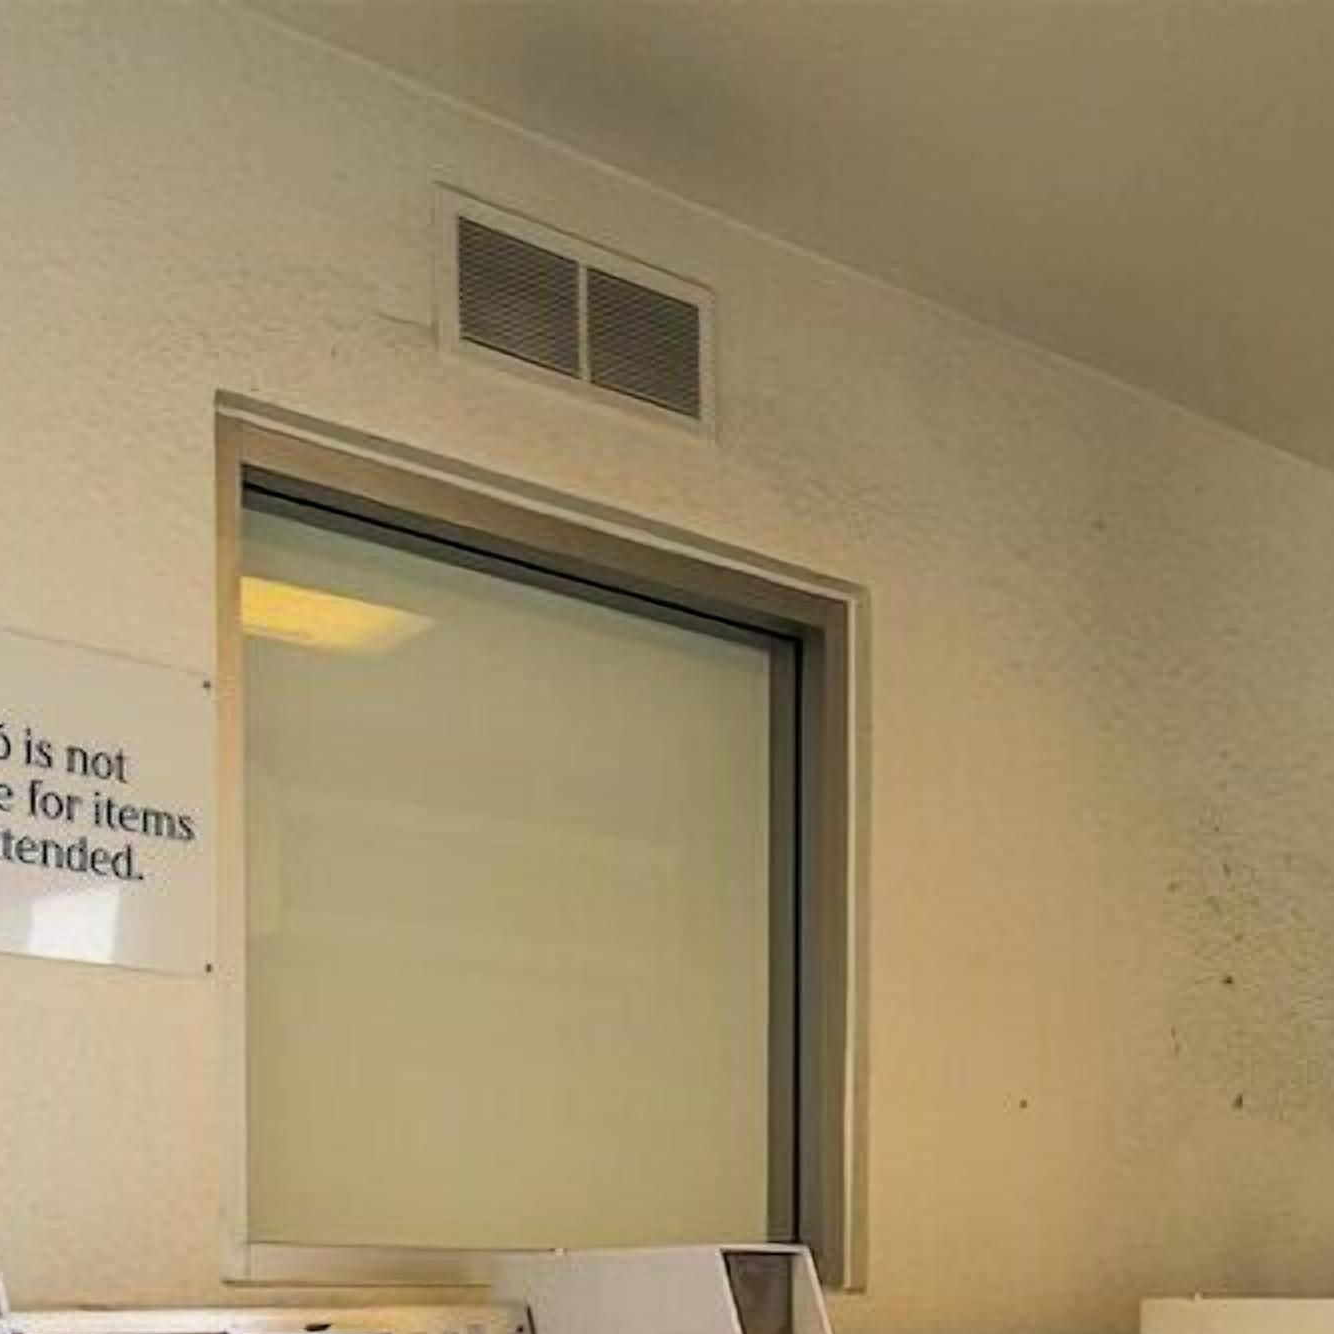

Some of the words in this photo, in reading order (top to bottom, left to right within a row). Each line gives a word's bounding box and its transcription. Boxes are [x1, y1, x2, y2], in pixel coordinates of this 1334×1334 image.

[24, 727, 53, 769] is
[66, 745, 128, 784] not
[28, 779, 83, 823] for
[92, 790, 196, 842] items
